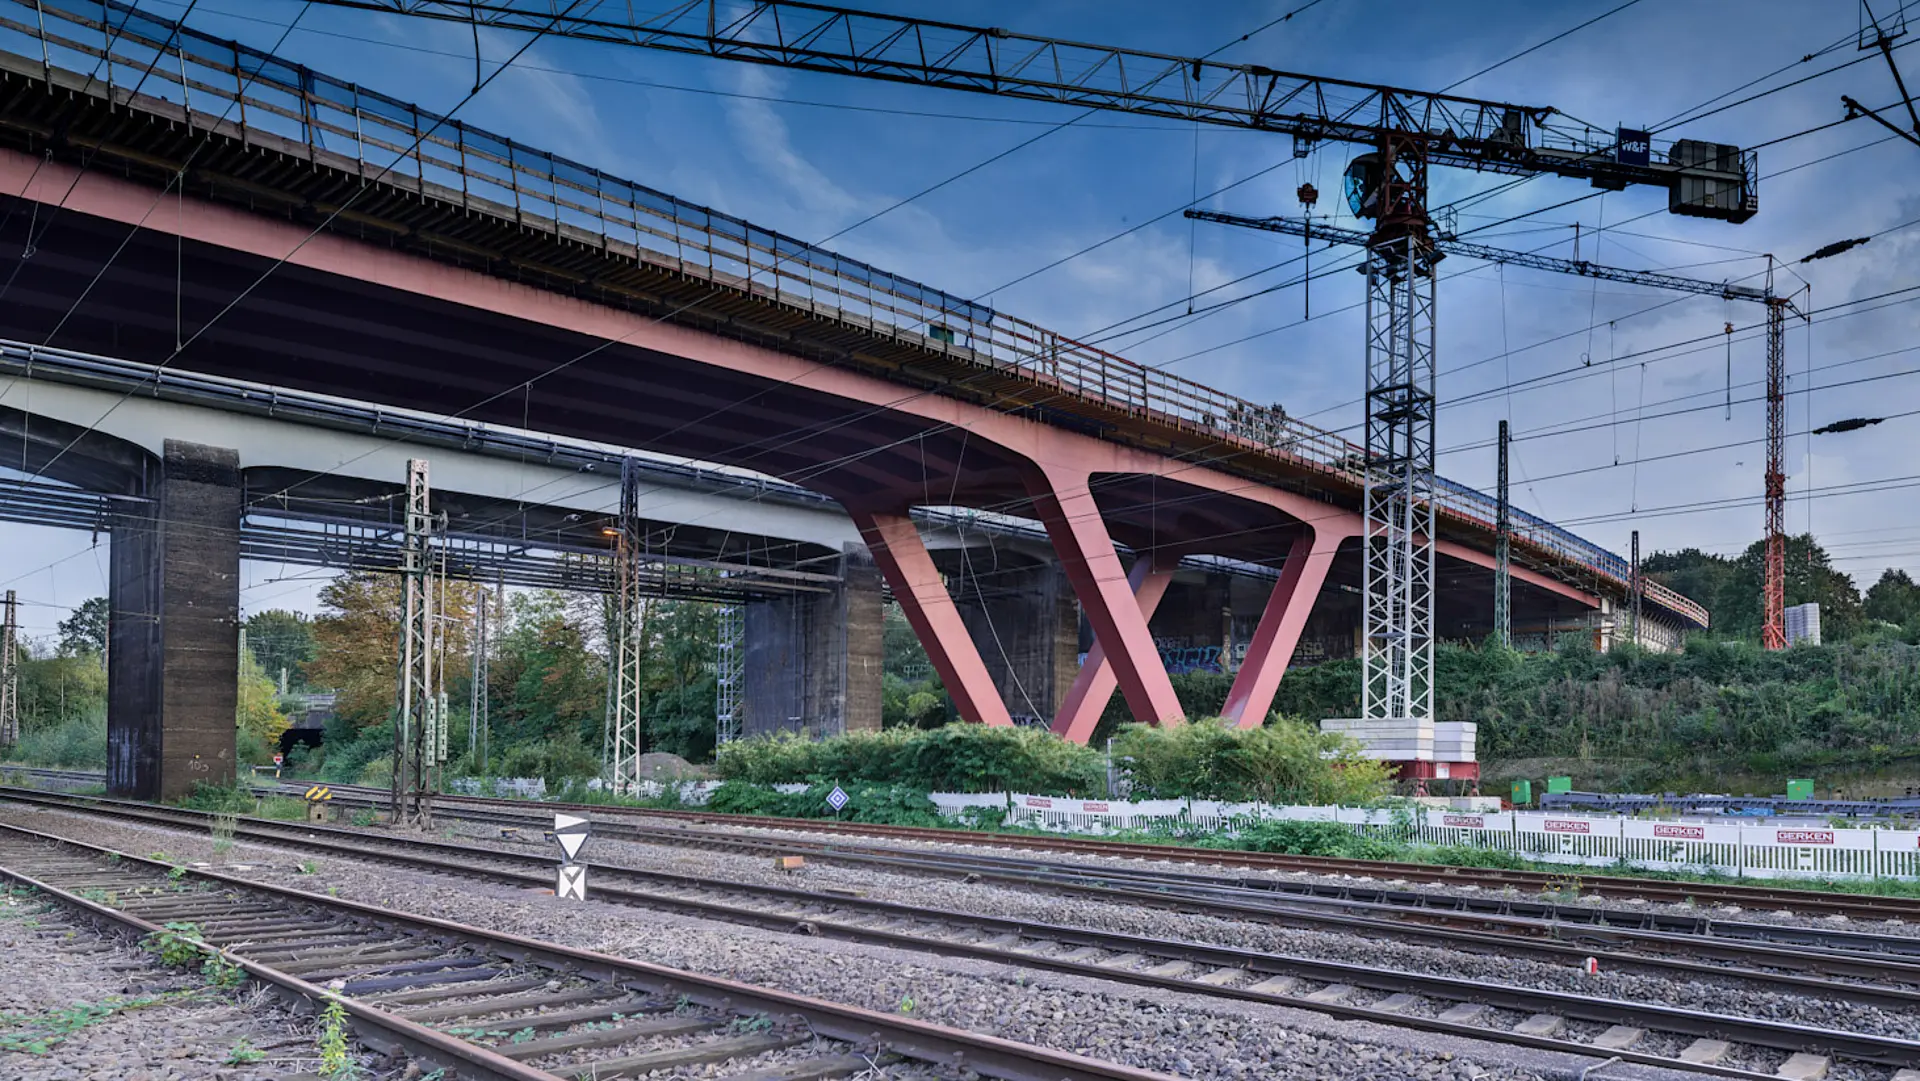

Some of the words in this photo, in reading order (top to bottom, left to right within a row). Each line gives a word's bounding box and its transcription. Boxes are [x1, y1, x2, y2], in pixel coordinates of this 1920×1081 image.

[1621, 139, 1647, 153] W&F
[1546, 822, 1588, 831] GERKEN
[1656, 827, 1703, 837] GERKEN
[1779, 832, 1832, 841] GERKEN
